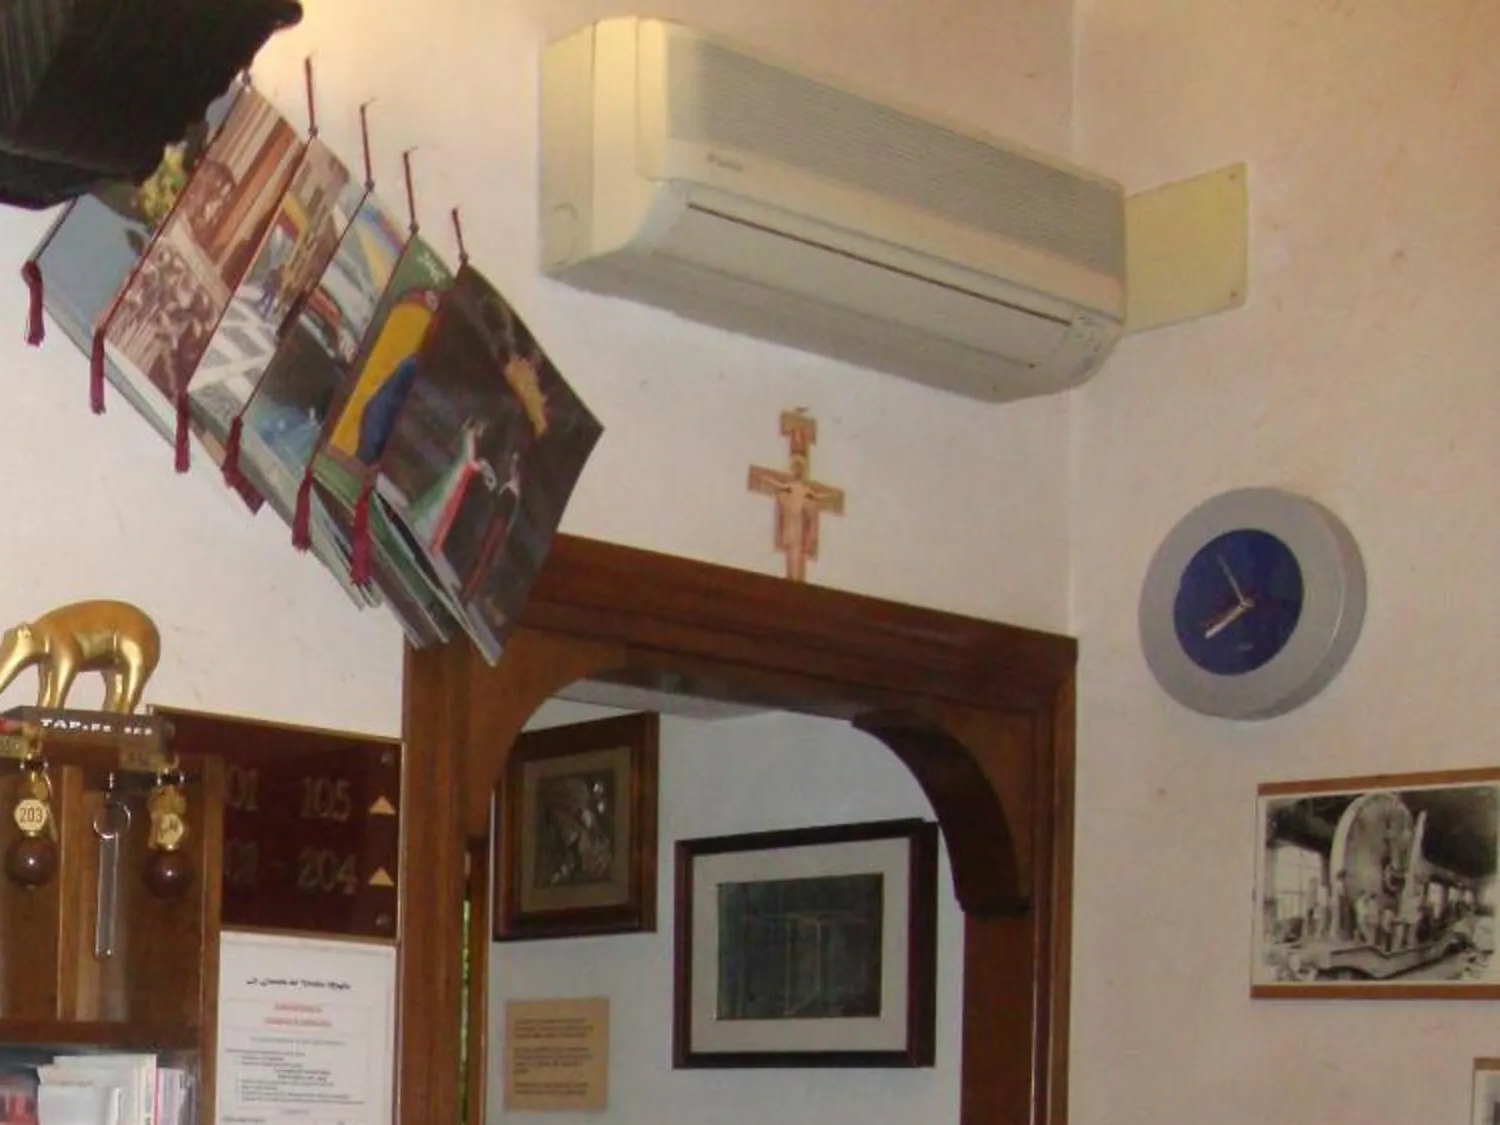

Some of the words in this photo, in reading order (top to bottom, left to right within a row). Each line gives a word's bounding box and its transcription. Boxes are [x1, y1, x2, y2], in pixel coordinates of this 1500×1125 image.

[19, 807, 44, 823] 203
[301, 775, 351, 822] 105
[298, 847, 358, 895] 204
